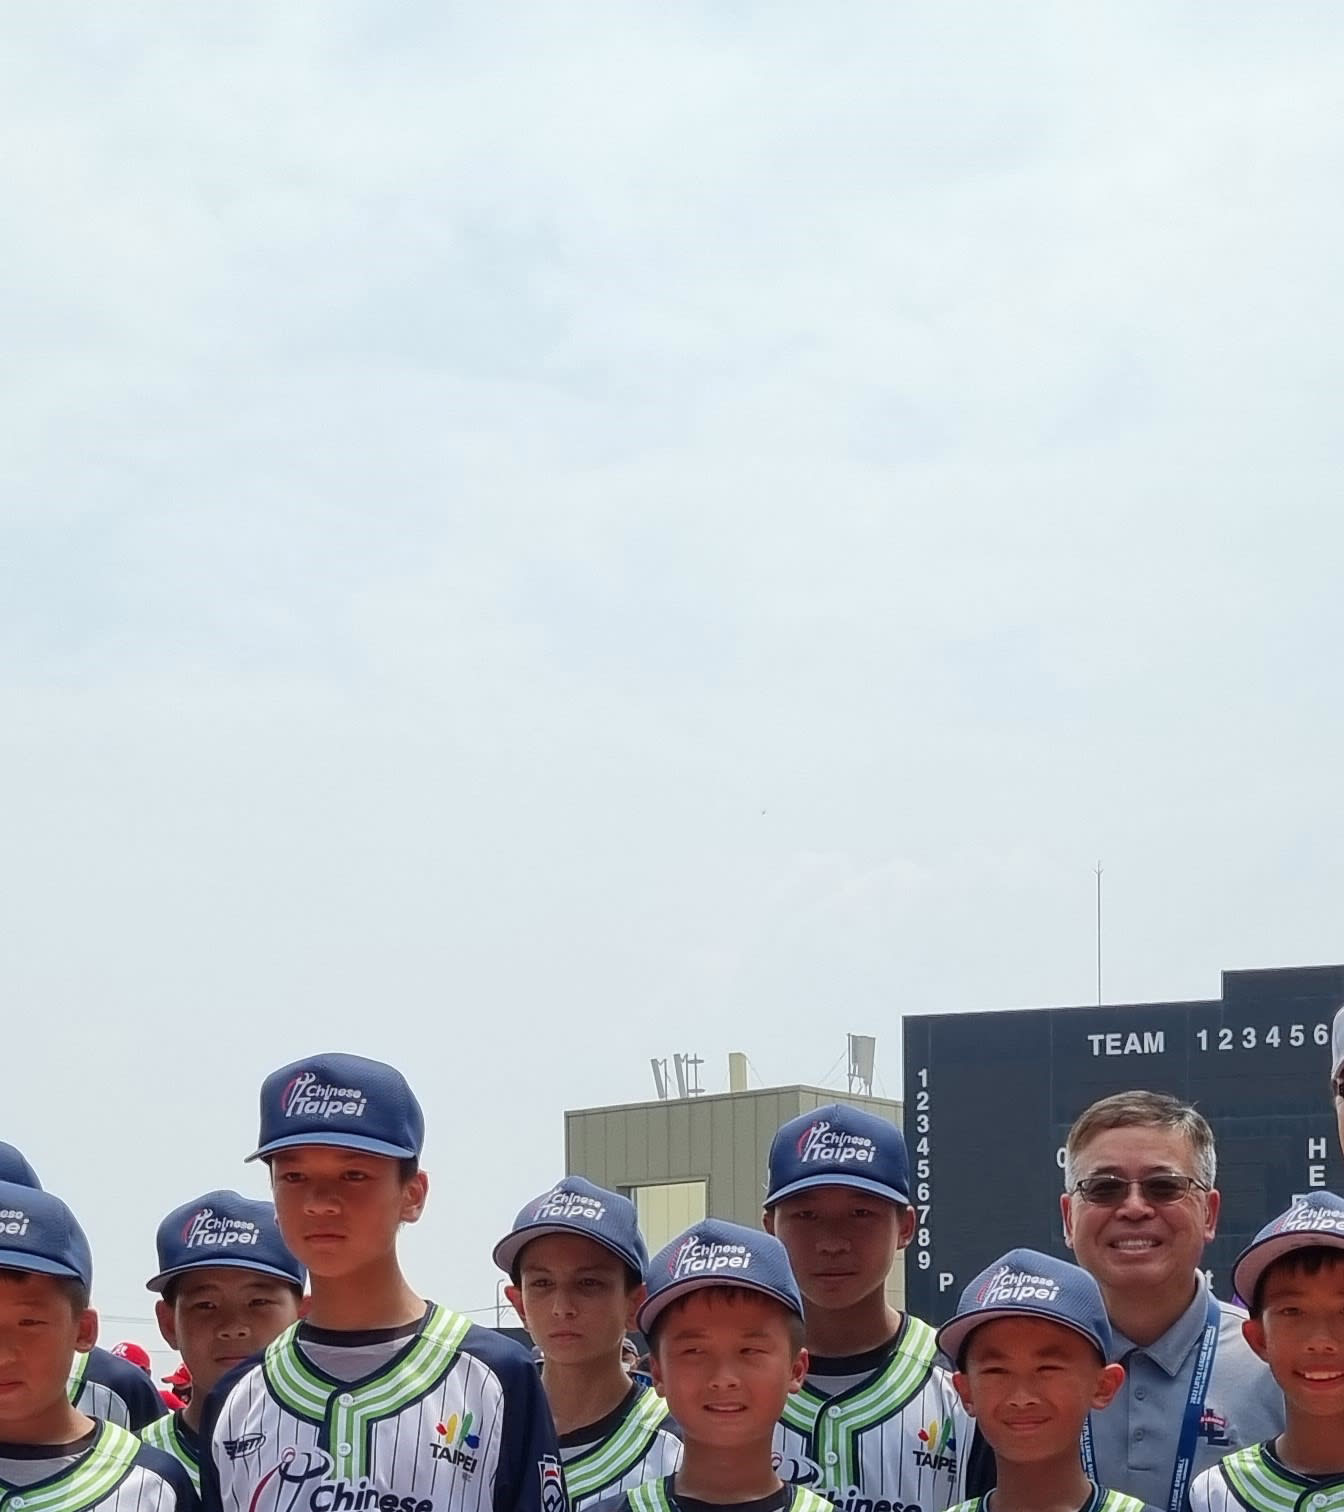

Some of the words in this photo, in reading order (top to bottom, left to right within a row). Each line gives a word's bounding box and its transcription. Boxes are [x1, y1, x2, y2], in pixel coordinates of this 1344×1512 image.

[1088, 1031, 1164, 1056] TEAM
[1197, 1030, 1208, 1051] 1
[1218, 1029, 1233, 1050] 2
[1242, 1027, 1256, 1049] 3
[1265, 1026, 1281, 1047] 4
[1290, 1025, 1304, 1046] 5
[1313, 1023, 1328, 1045] 6
[918, 1068, 929, 1087] 1
[305, 1084, 362, 1099] Chinese
[295, 1097, 367, 1118] Taipei
[917, 1092, 929, 1111] 2
[917, 1115, 929, 1133] 3
[821, 1132, 871, 1147] Chinese
[916, 1137, 930, 1156] 4
[1308, 1138, 1326, 1159] H
[812, 1144, 876, 1162] Taipei
[917, 1160, 930, 1179] 5
[1309, 1165, 1325, 1187] E
[551, 1192, 601, 1208] Chinese
[917, 1183, 930, 1202] 6
[540, 1203, 606, 1220] Taipei
[917, 1206, 930, 1224] 7
[205, 1217, 255, 1230] Chinese
[196, 1229, 260, 1247] Taipei
[918, 1228, 930, 1247] 8
[691, 1243, 745, 1256] Chinese
[682, 1252, 752, 1274] Taipei
[918, 1251, 931, 1269] 9
[940, 1273, 953, 1292] P
[1000, 1272, 1054, 1286] Chinese
[990, 1286, 1060, 1303] Taipei
[429, 1443, 478, 1474] TAIPEI
[913, 1450, 957, 1473] TAIPE
